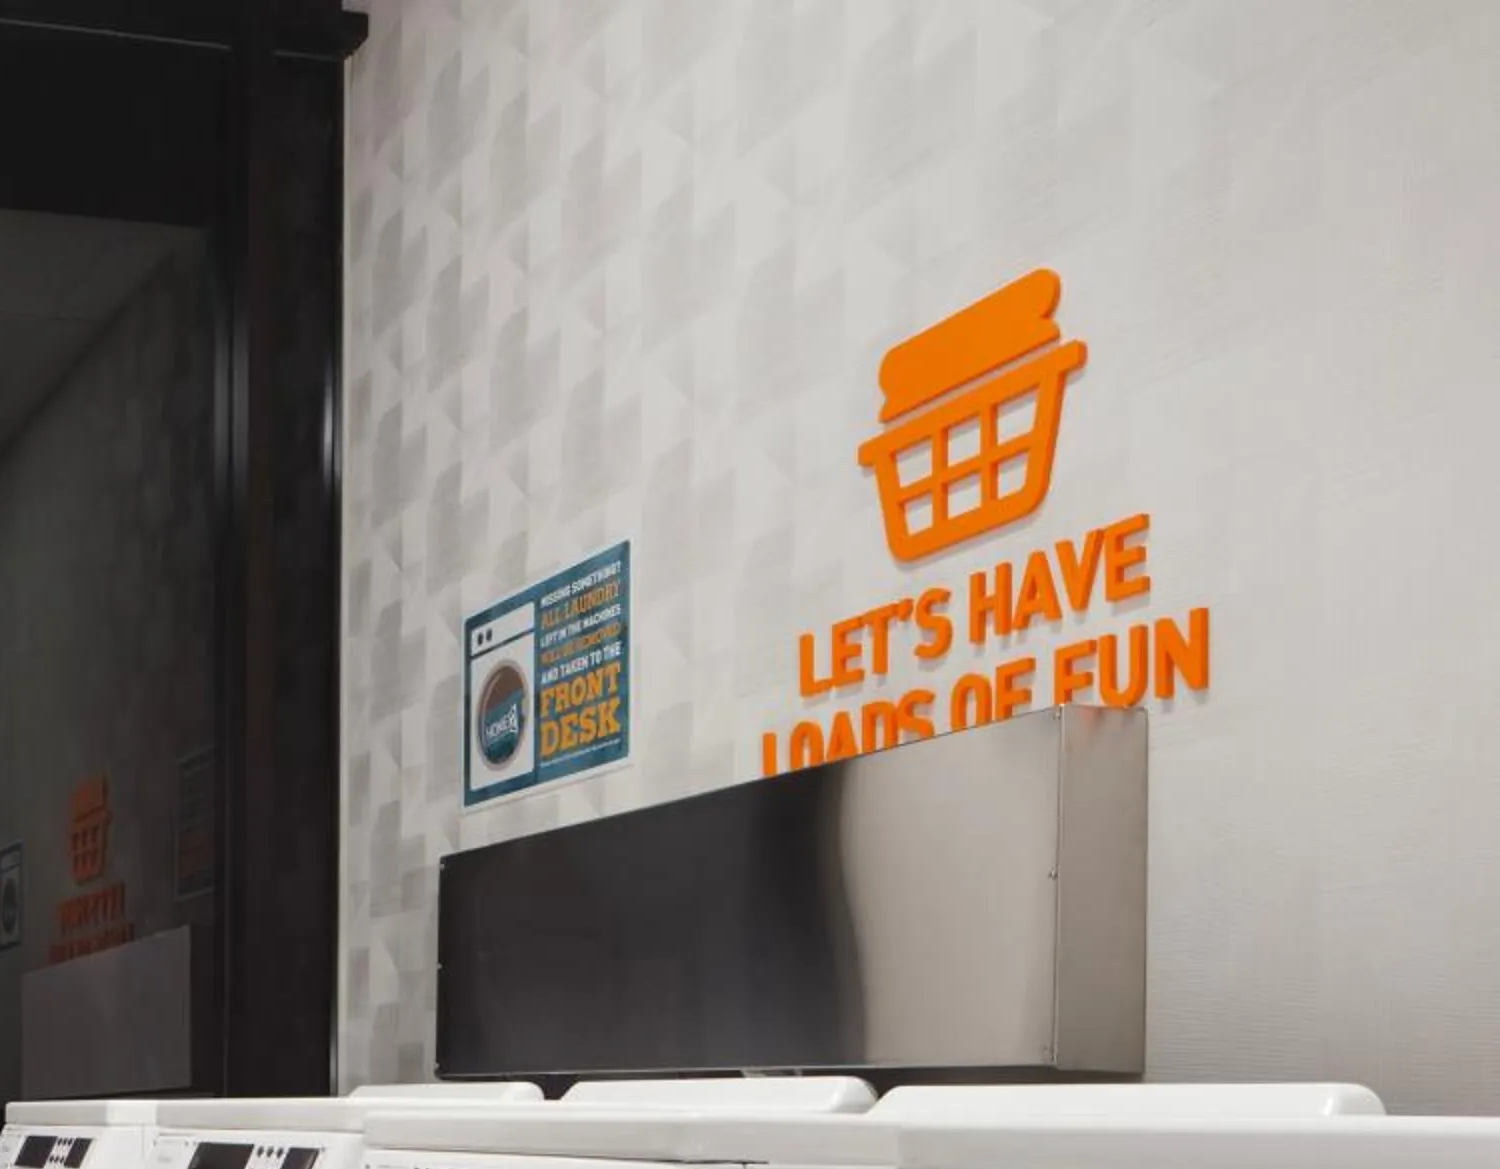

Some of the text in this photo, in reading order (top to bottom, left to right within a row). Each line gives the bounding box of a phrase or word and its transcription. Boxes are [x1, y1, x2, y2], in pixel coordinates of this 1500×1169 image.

[799, 513, 1151, 697] LET'S HAVE
[590, 649, 602, 666] TO
[950, 657, 1037, 733] OF
[1054, 607, 1210, 709] FUN
[540, 661, 621, 718] FRONT
[540, 696, 621, 757] DESK
